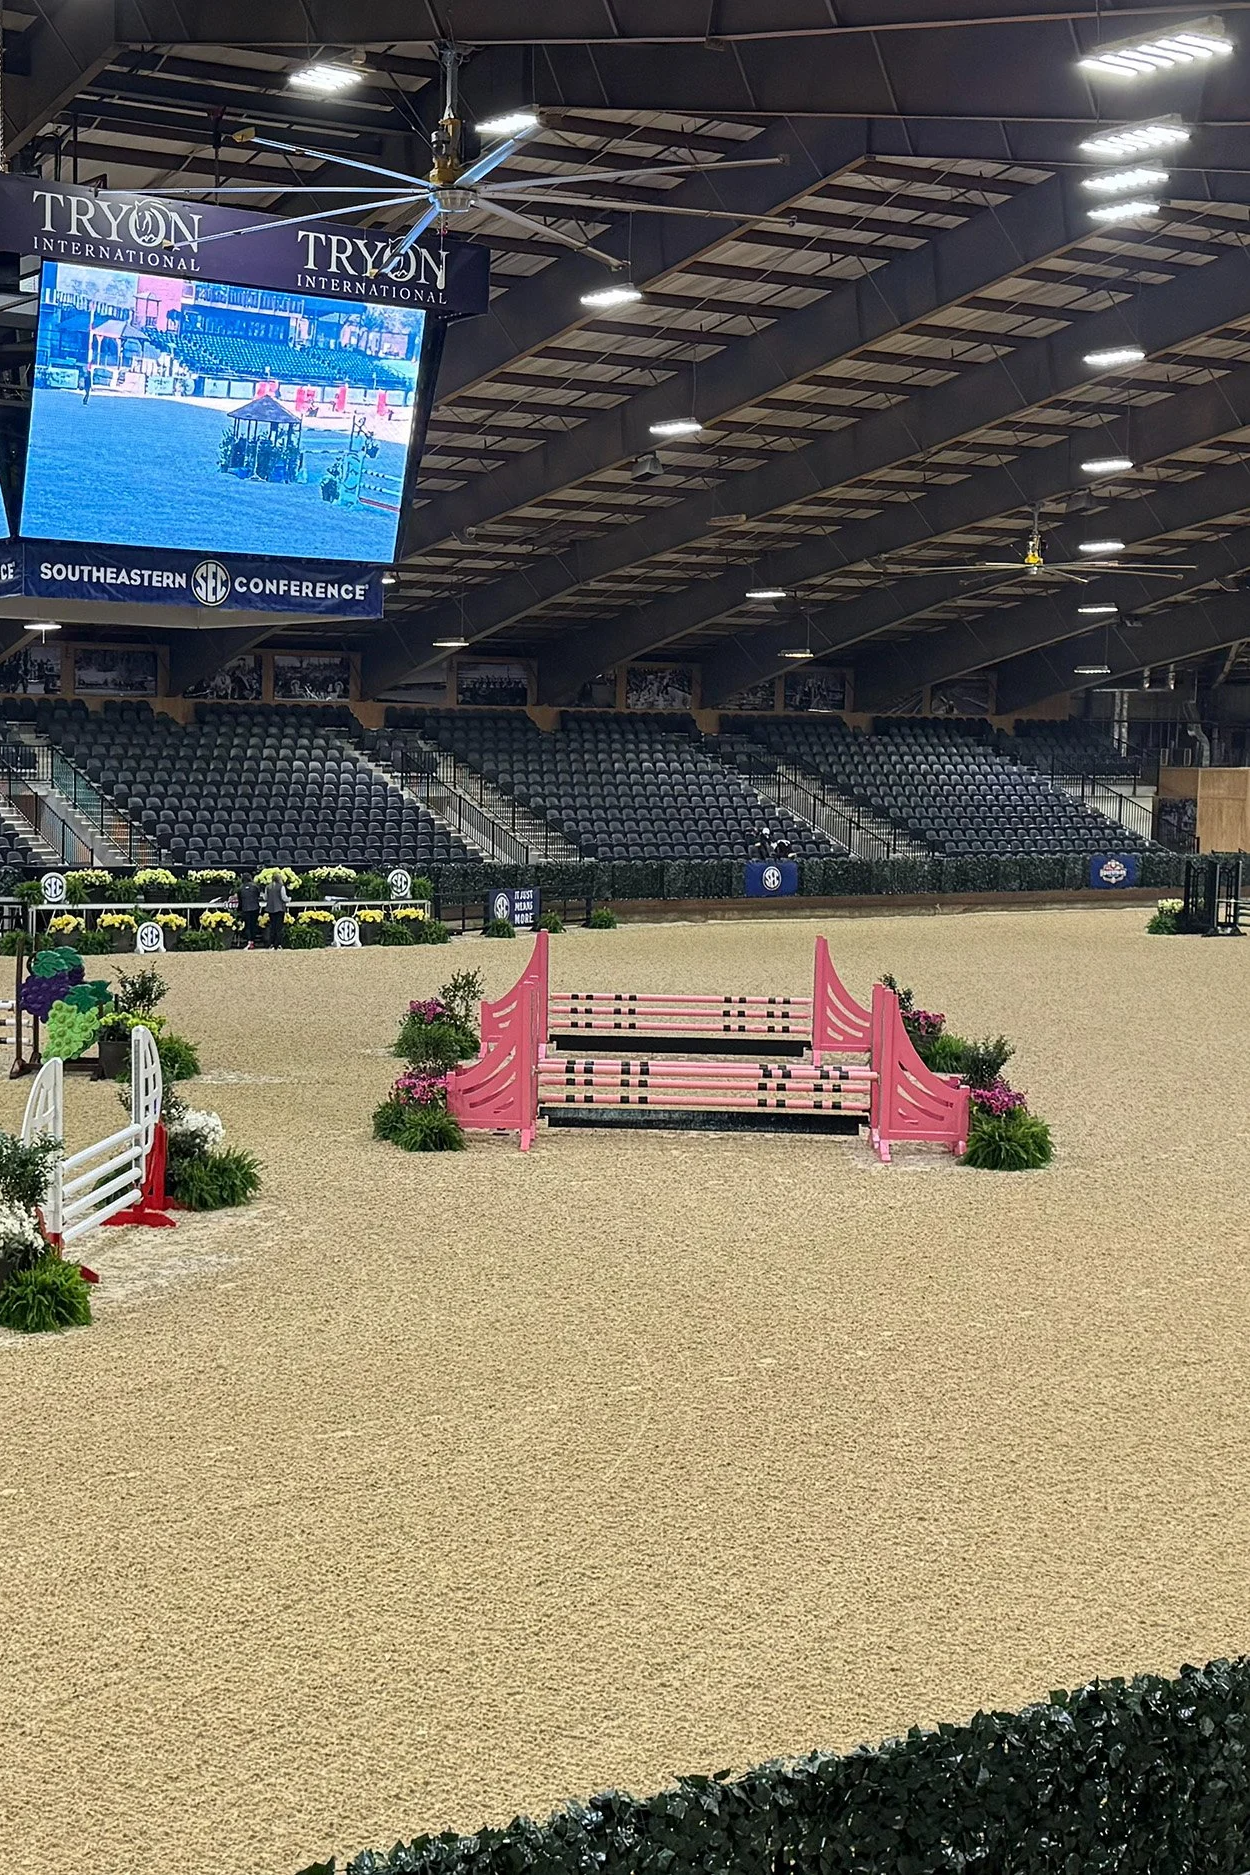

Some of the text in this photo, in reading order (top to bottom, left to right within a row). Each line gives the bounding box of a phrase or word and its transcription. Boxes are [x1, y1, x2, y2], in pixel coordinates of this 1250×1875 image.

[32, 190, 202, 253] TRYON
[33, 236, 200, 271] INTERNATIONAL
[297, 230, 450, 289] TRYON
[297, 274, 448, 304] INTERNATIONAL
[40, 563, 187, 589] SOUTHEASTERN
[194, 562, 228, 603] SEC
[44, 875, 63, 898] SEC
[140, 926, 160, 946] SEC
